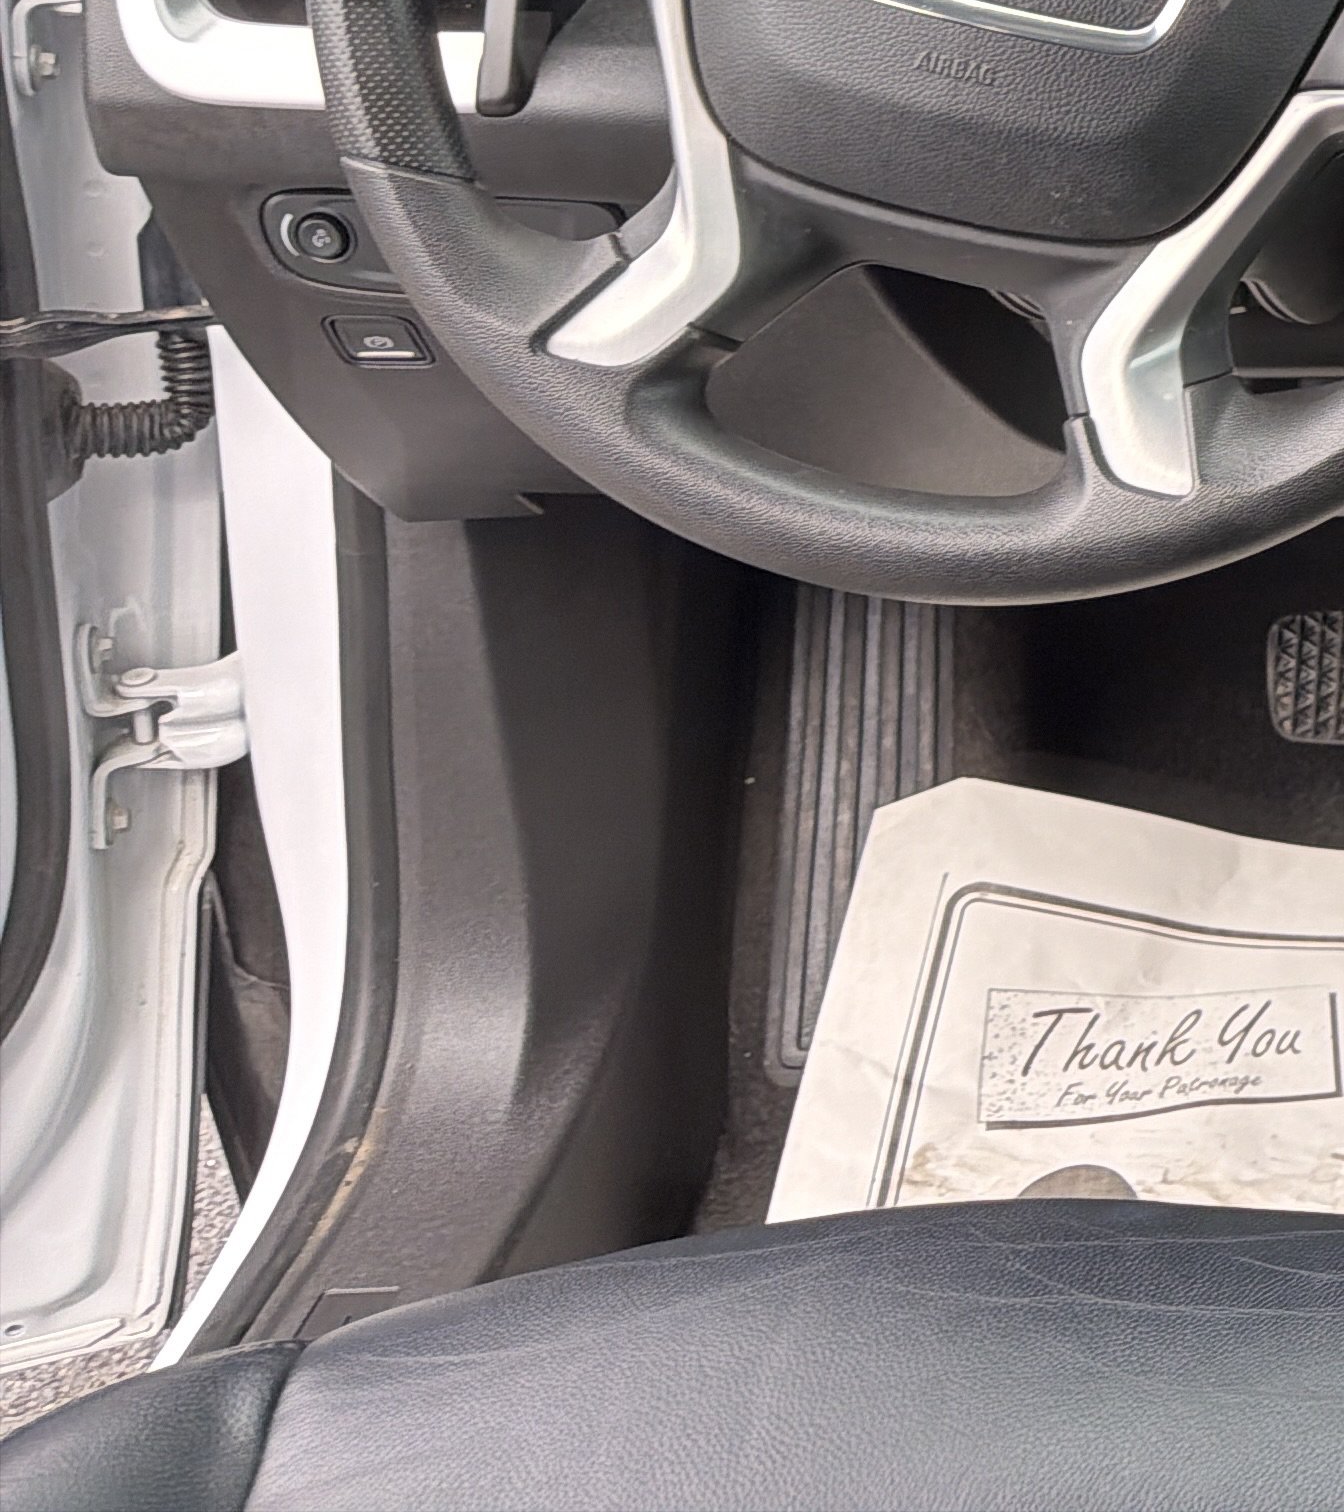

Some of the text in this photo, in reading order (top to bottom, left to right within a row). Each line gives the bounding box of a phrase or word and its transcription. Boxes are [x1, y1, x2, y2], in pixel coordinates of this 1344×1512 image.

[913, 49, 994, 86] AIRBAG
[1021, 999, 1302, 1078] Thank You
[1055, 1074, 1262, 1107] For Your Patronage
